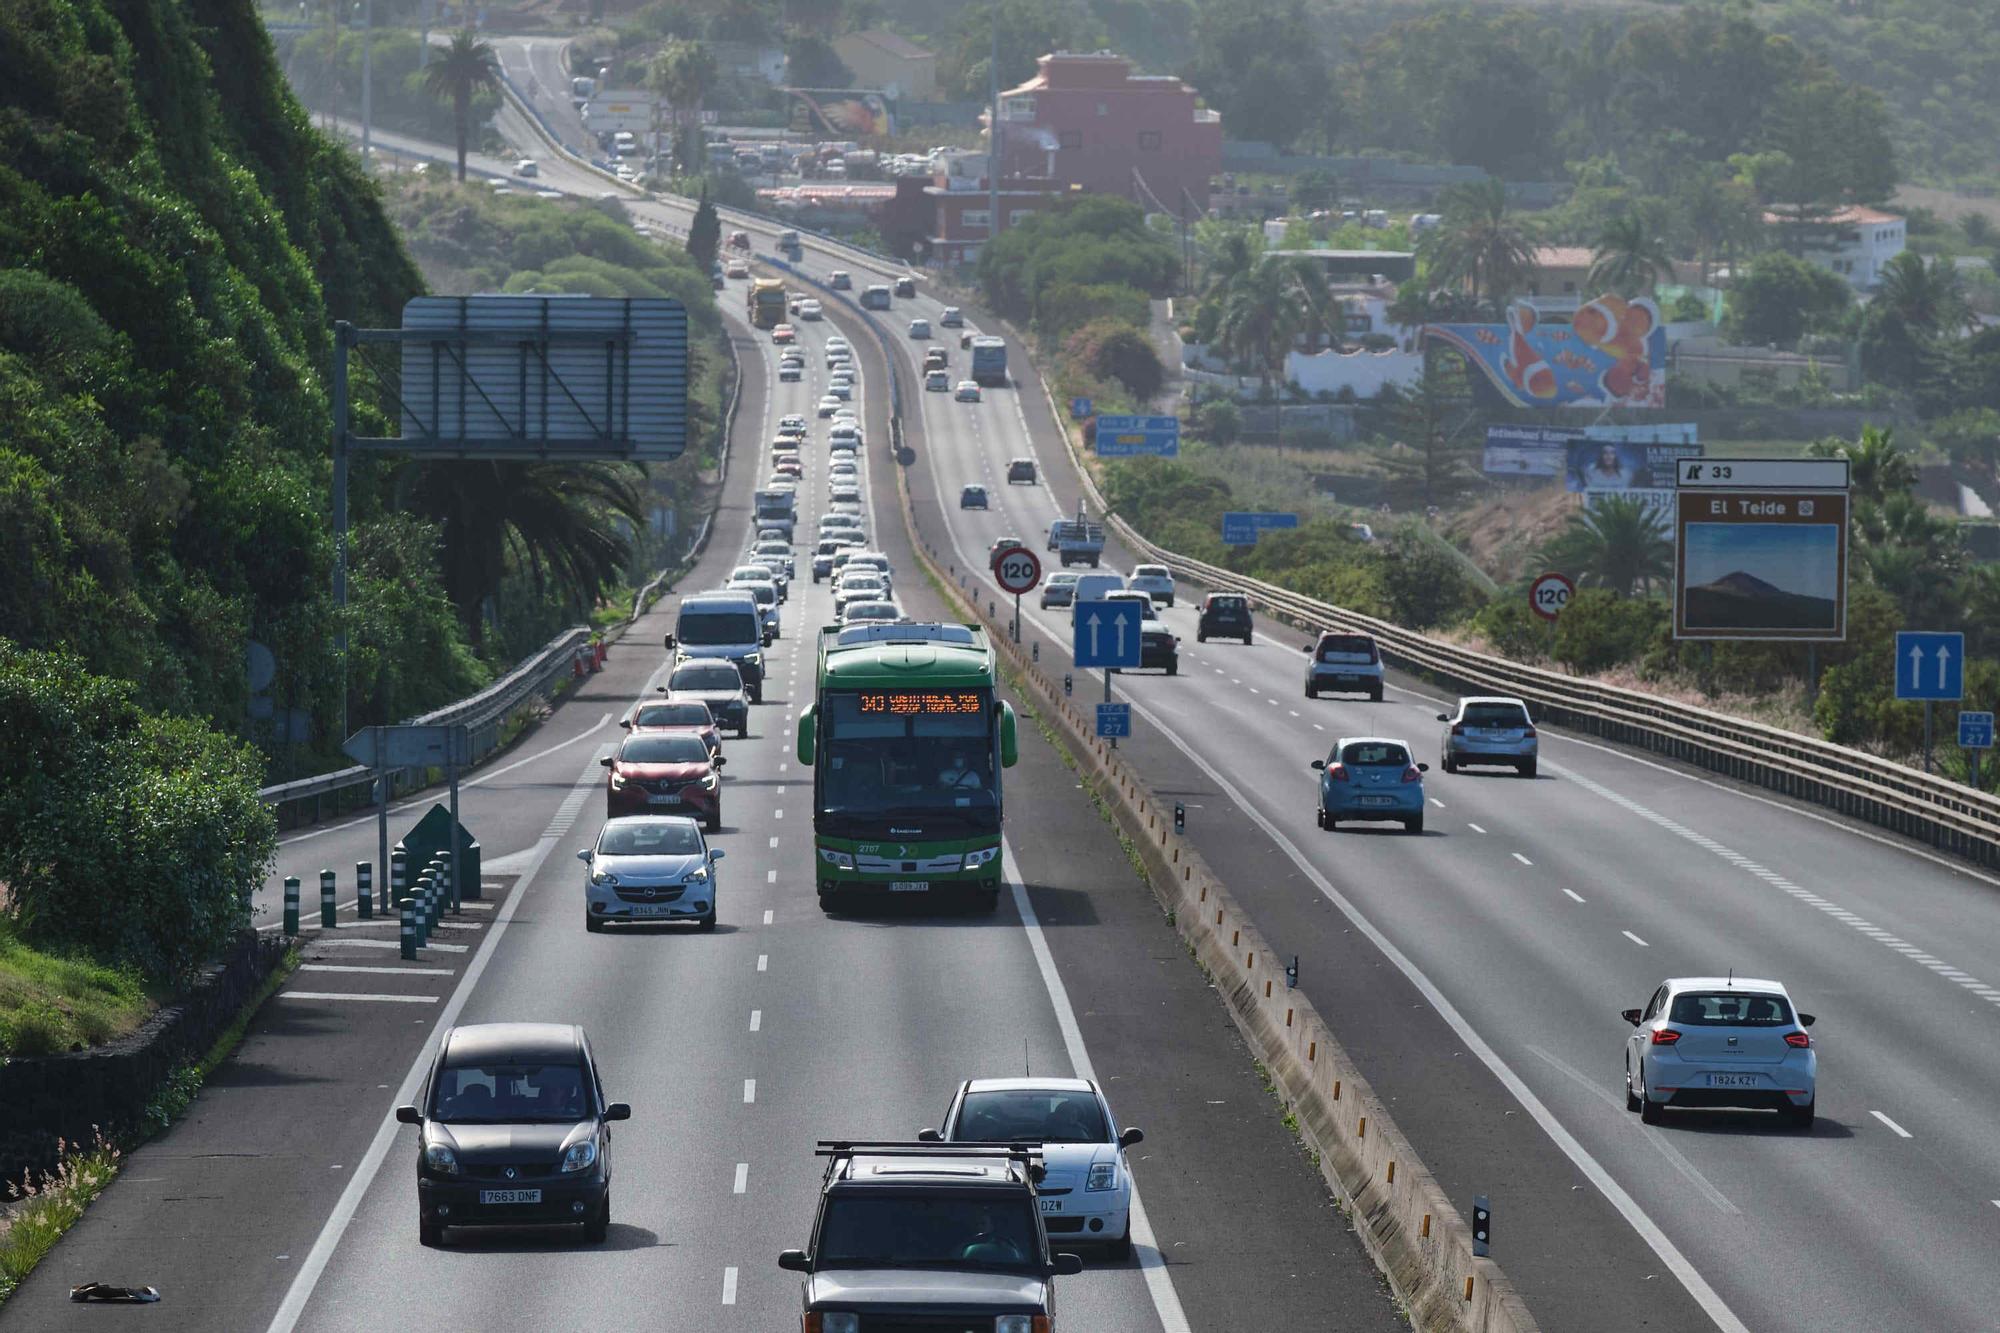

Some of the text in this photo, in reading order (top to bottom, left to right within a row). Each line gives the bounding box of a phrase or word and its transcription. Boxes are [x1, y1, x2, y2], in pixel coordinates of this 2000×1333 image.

[1712, 466, 1732, 479] 33
[1711, 500, 1787, 514] El Teide
[1002, 562, 1034, 579] 120
[1537, 588, 1569, 605] 120
[1104, 723, 1121, 735] 27
[1967, 733, 1984, 745] 27
[1714, 1075, 1736, 1086] 1824
[487, 1190, 538, 1202] 7663 DNF
